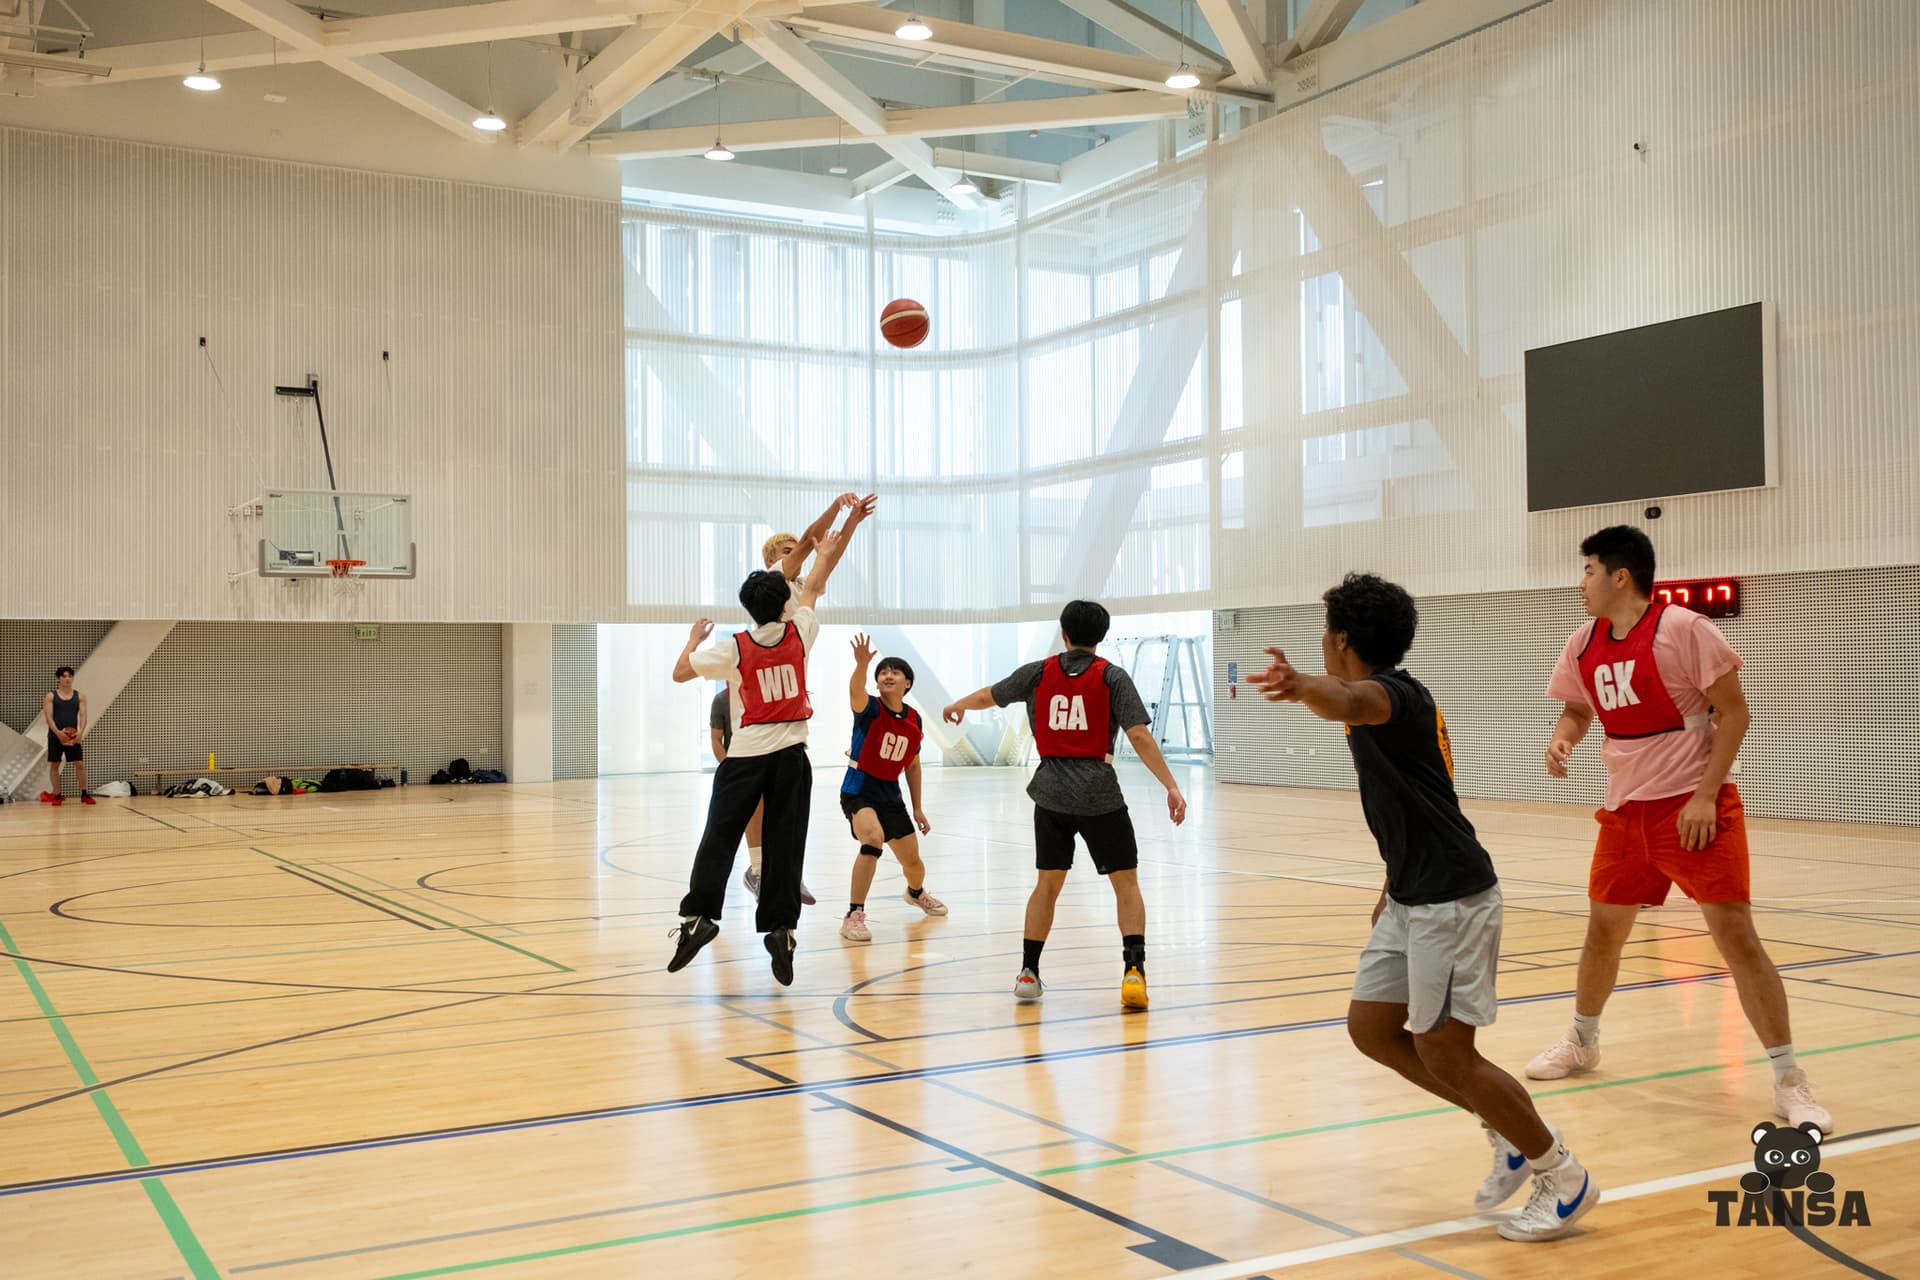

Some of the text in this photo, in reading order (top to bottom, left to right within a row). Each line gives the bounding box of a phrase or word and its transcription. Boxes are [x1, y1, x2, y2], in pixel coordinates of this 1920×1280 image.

[755, 663, 799, 704] WD
[1593, 659, 1641, 711] GK
[1048, 694, 1089, 731] GA
[879, 731, 909, 762] GD
